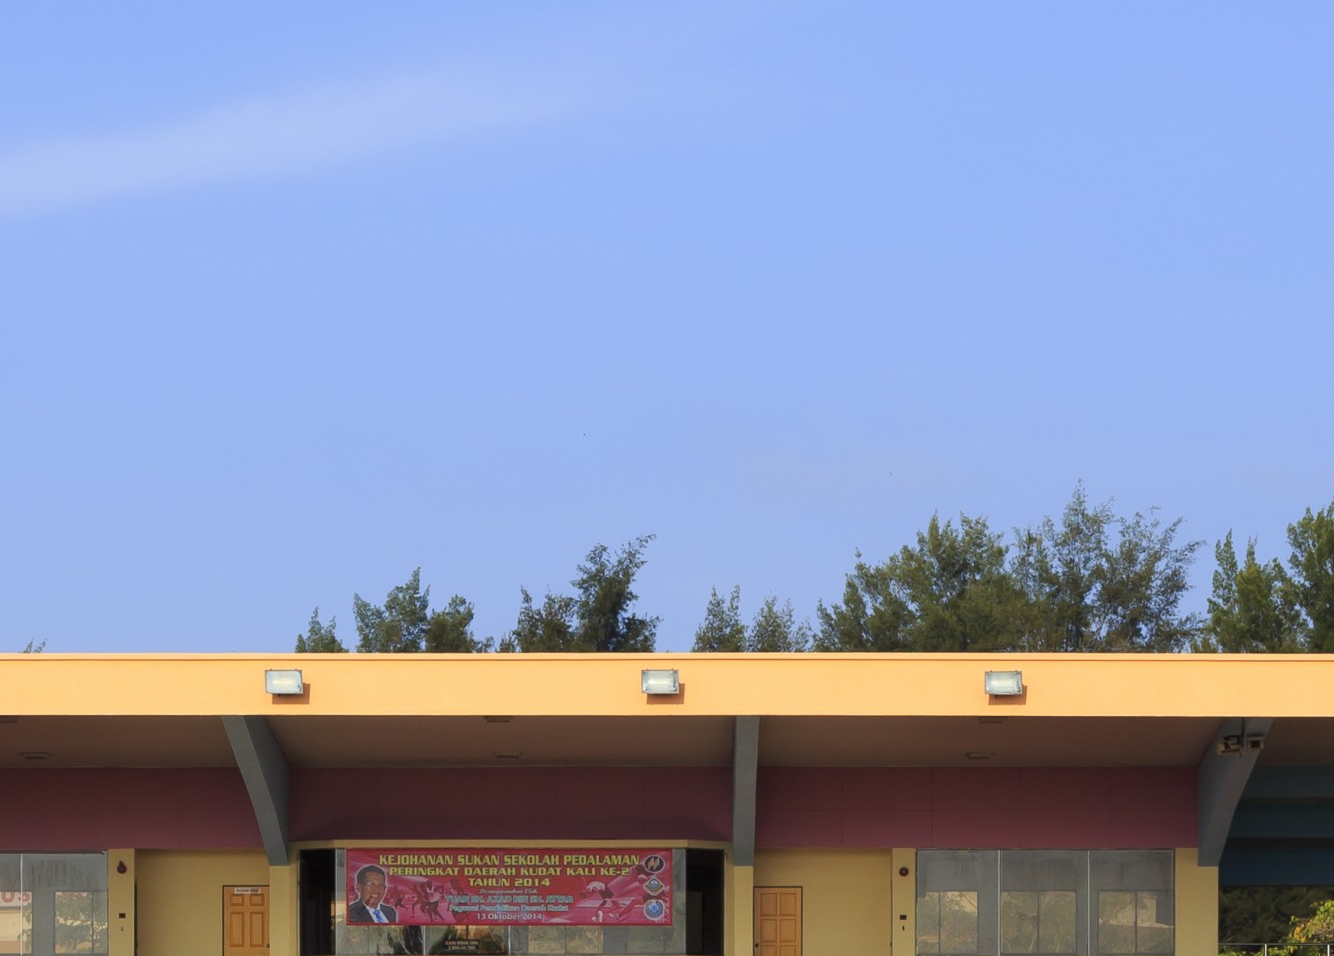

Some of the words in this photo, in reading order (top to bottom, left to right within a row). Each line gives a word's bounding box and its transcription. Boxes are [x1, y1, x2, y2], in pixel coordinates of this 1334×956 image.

[379, 854, 453, 866] KEJOHANAN
[457, 854, 500, 866] SUKAN
[503, 854, 560, 866] SEKOLAH
[563, 854, 640, 866] PEDALAMAN
[389, 867, 459, 876] PERINGKAT
[464, 867, 516, 876] DAERAH
[520, 867, 562, 876] KUDAT
[566, 867, 596, 876] KALI
[600, 867, 629, 876] KE-2
[468, 878, 510, 887] TAHUN
[514, 878, 551, 887] 2014
